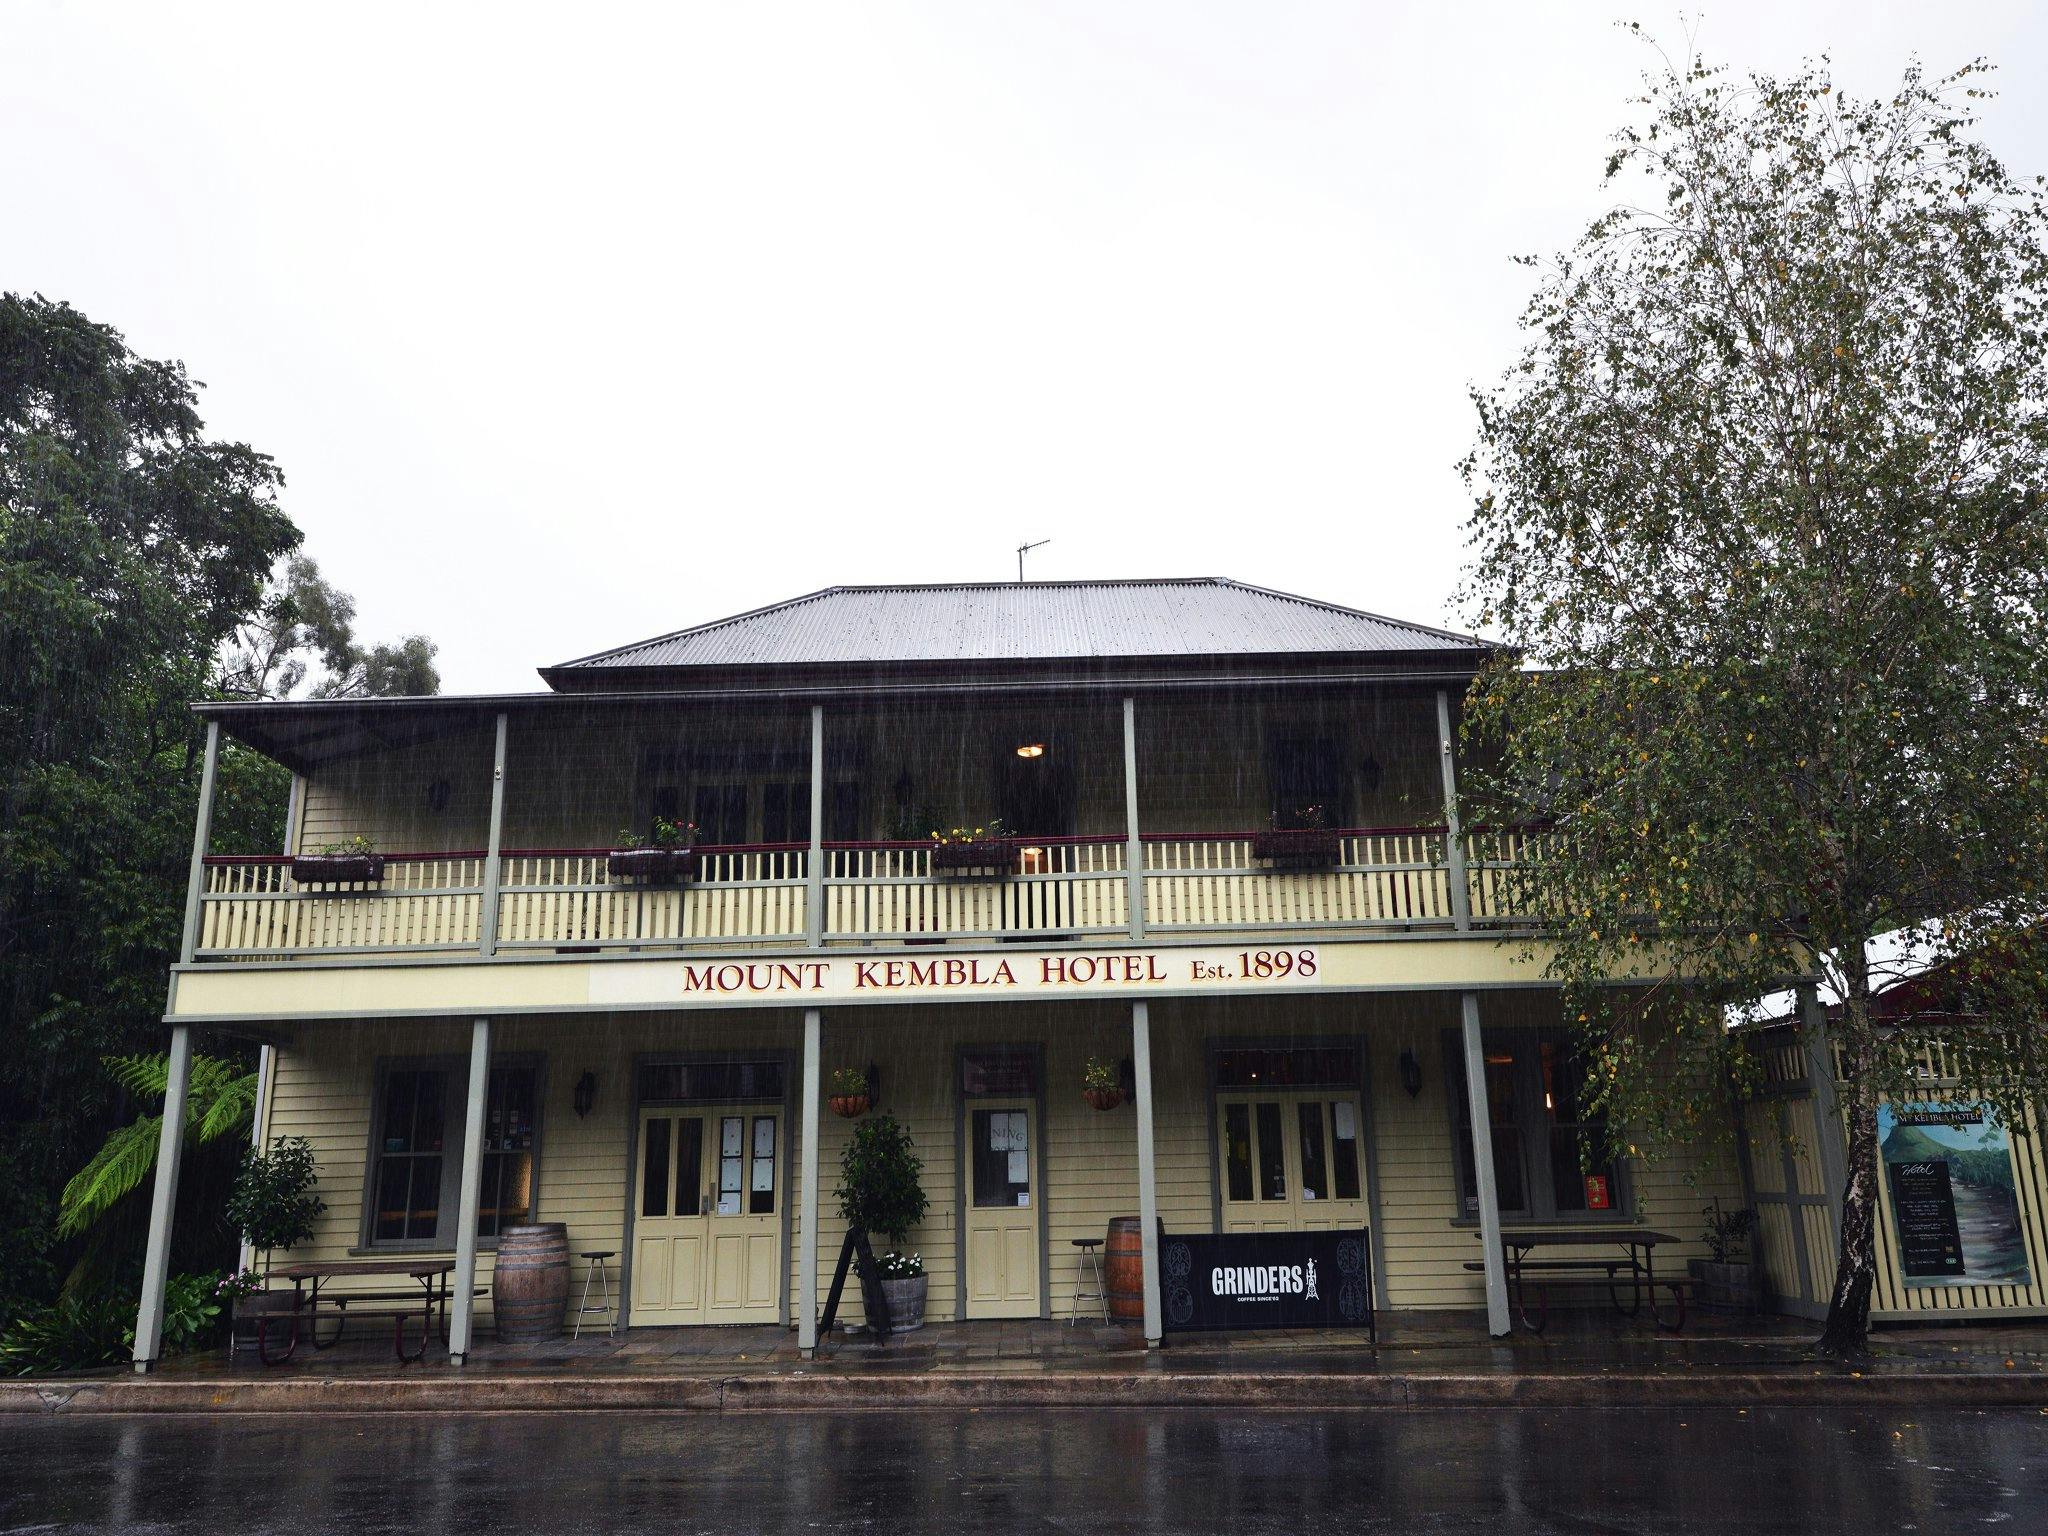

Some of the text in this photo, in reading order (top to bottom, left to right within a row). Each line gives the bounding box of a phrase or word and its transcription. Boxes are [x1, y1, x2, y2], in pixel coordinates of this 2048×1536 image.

[684, 949, 1317, 992] MOUNT KEMBLA HOTEL Est. 1898
[1212, 1265, 1304, 1296] GRINDERS
